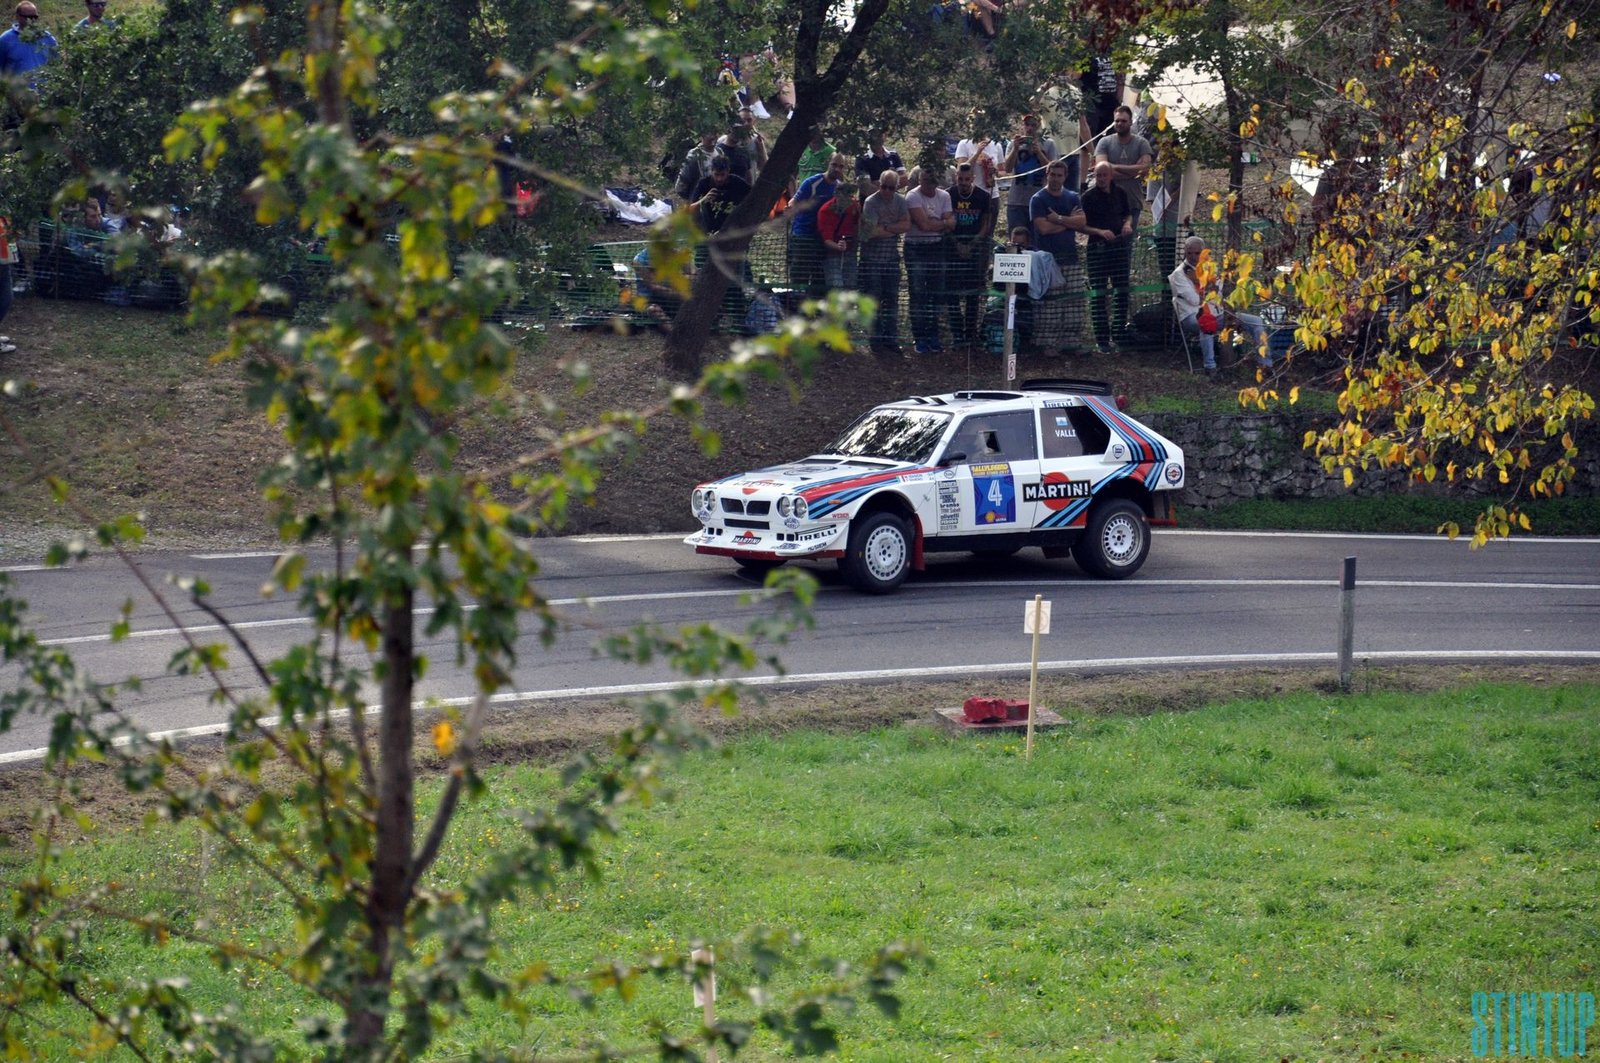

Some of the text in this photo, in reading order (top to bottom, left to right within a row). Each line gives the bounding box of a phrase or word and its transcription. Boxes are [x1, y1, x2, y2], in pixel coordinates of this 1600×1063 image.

[1055, 429, 1076, 437] VALLI
[987, 479, 1003, 507] 4
[794, 523, 838, 542] PIRELLI
